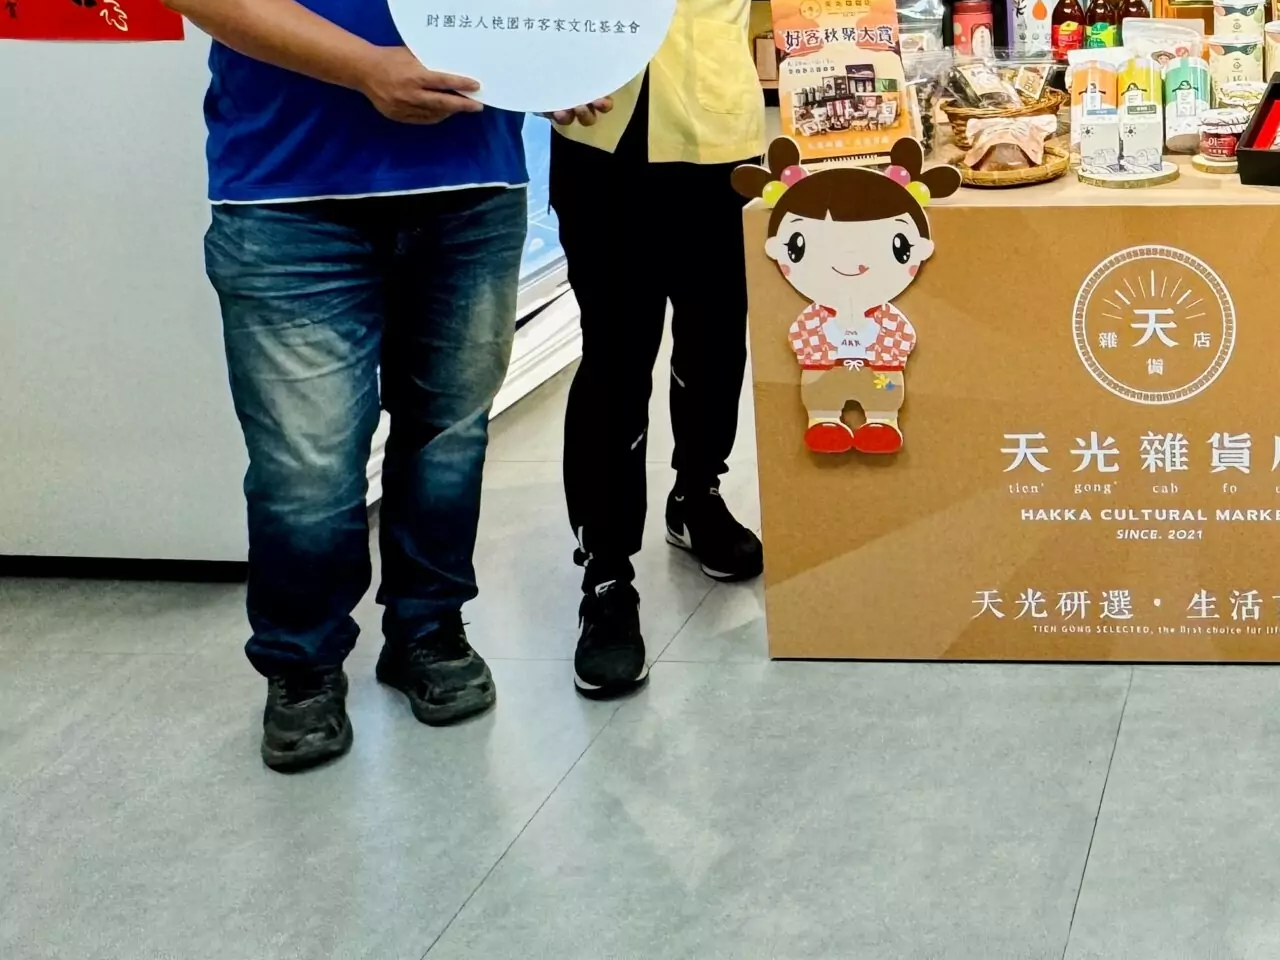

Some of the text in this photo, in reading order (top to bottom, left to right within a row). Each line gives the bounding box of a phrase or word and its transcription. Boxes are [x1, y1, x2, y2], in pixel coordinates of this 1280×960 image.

[426, 14, 640, 34] 財團法人桃園市客家文化基金會
[784, 25, 895, 51] 好客秋聚大賞
[1130, 307, 1180, 347] 天
[1020, 508, 1093, 521] HAKKA
[1100, 508, 1207, 521] CULTURAL
[1168, 529, 1204, 540] 2021
[1033, 624, 1057, 634] TIEN
[1061, 624, 1092, 634] GONG
[1158, 625, 1176, 635] the
